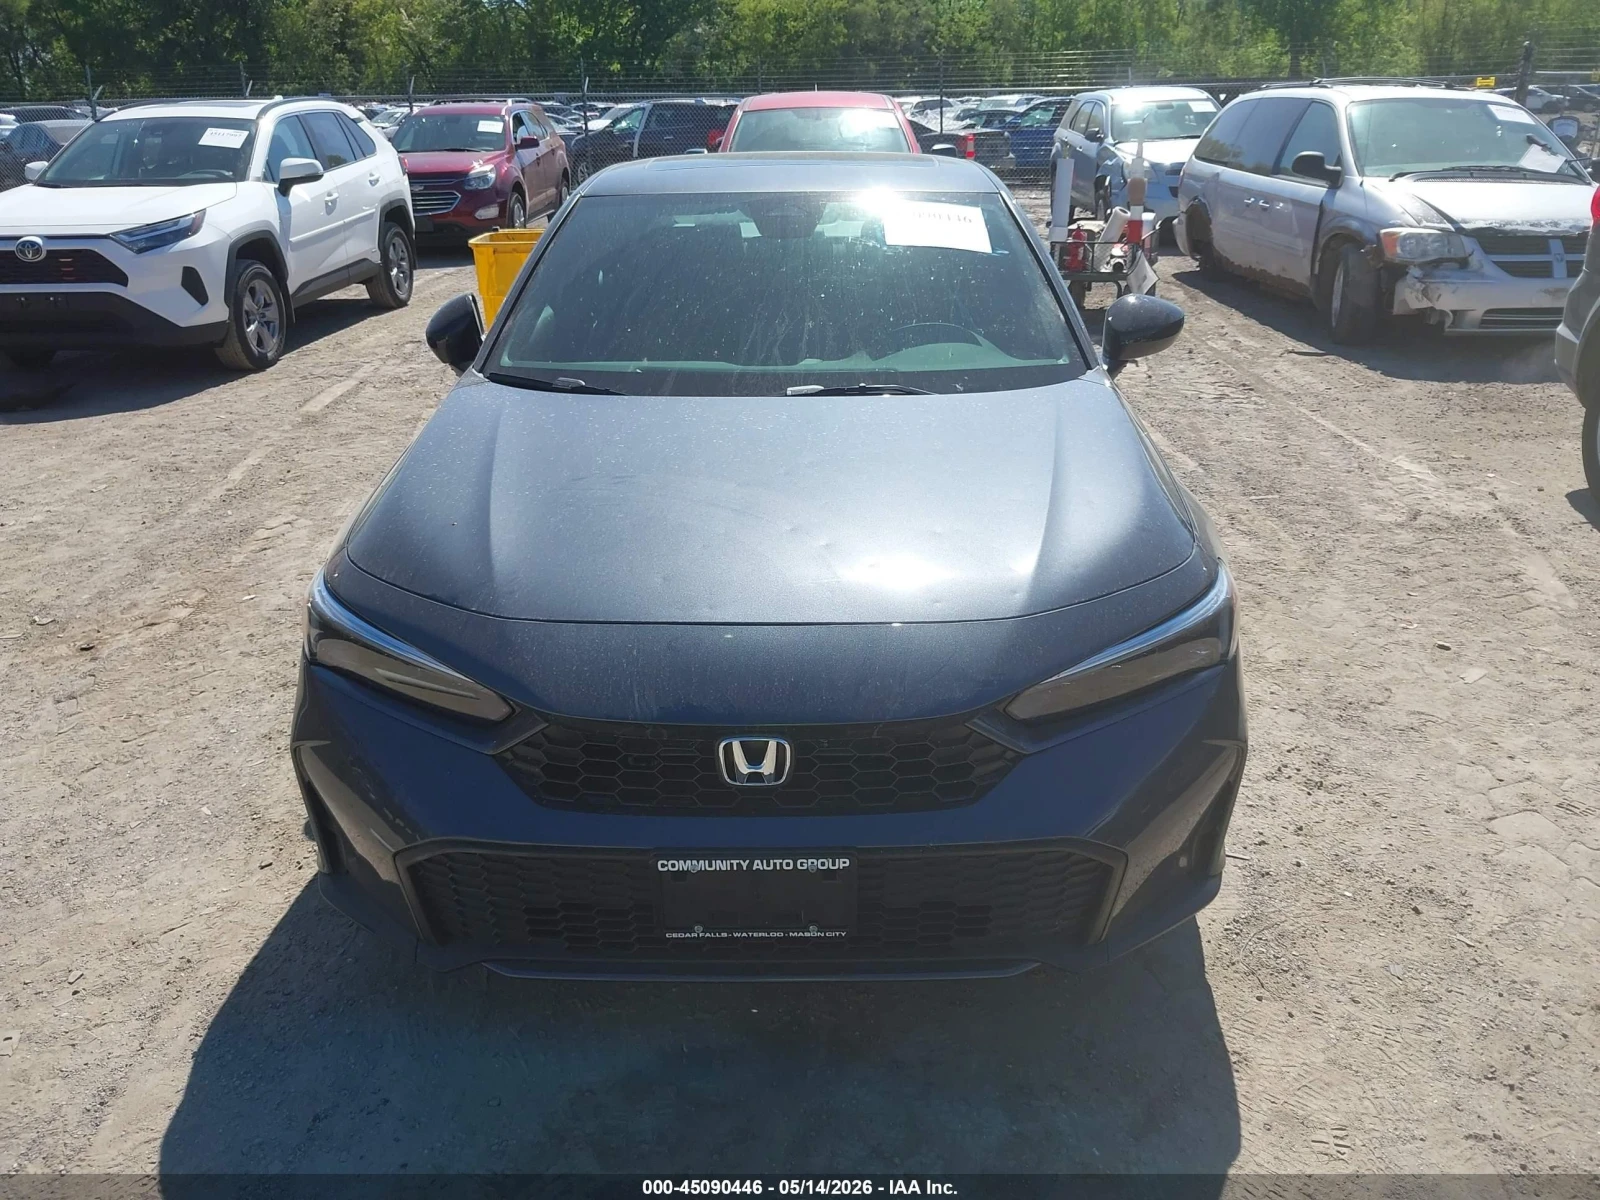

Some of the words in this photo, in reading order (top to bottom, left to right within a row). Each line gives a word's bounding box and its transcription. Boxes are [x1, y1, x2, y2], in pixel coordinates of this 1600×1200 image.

[657, 859, 750, 873] COMMUNITY
[752, 859, 794, 871] AUTO
[796, 858, 850, 872] GROUP
